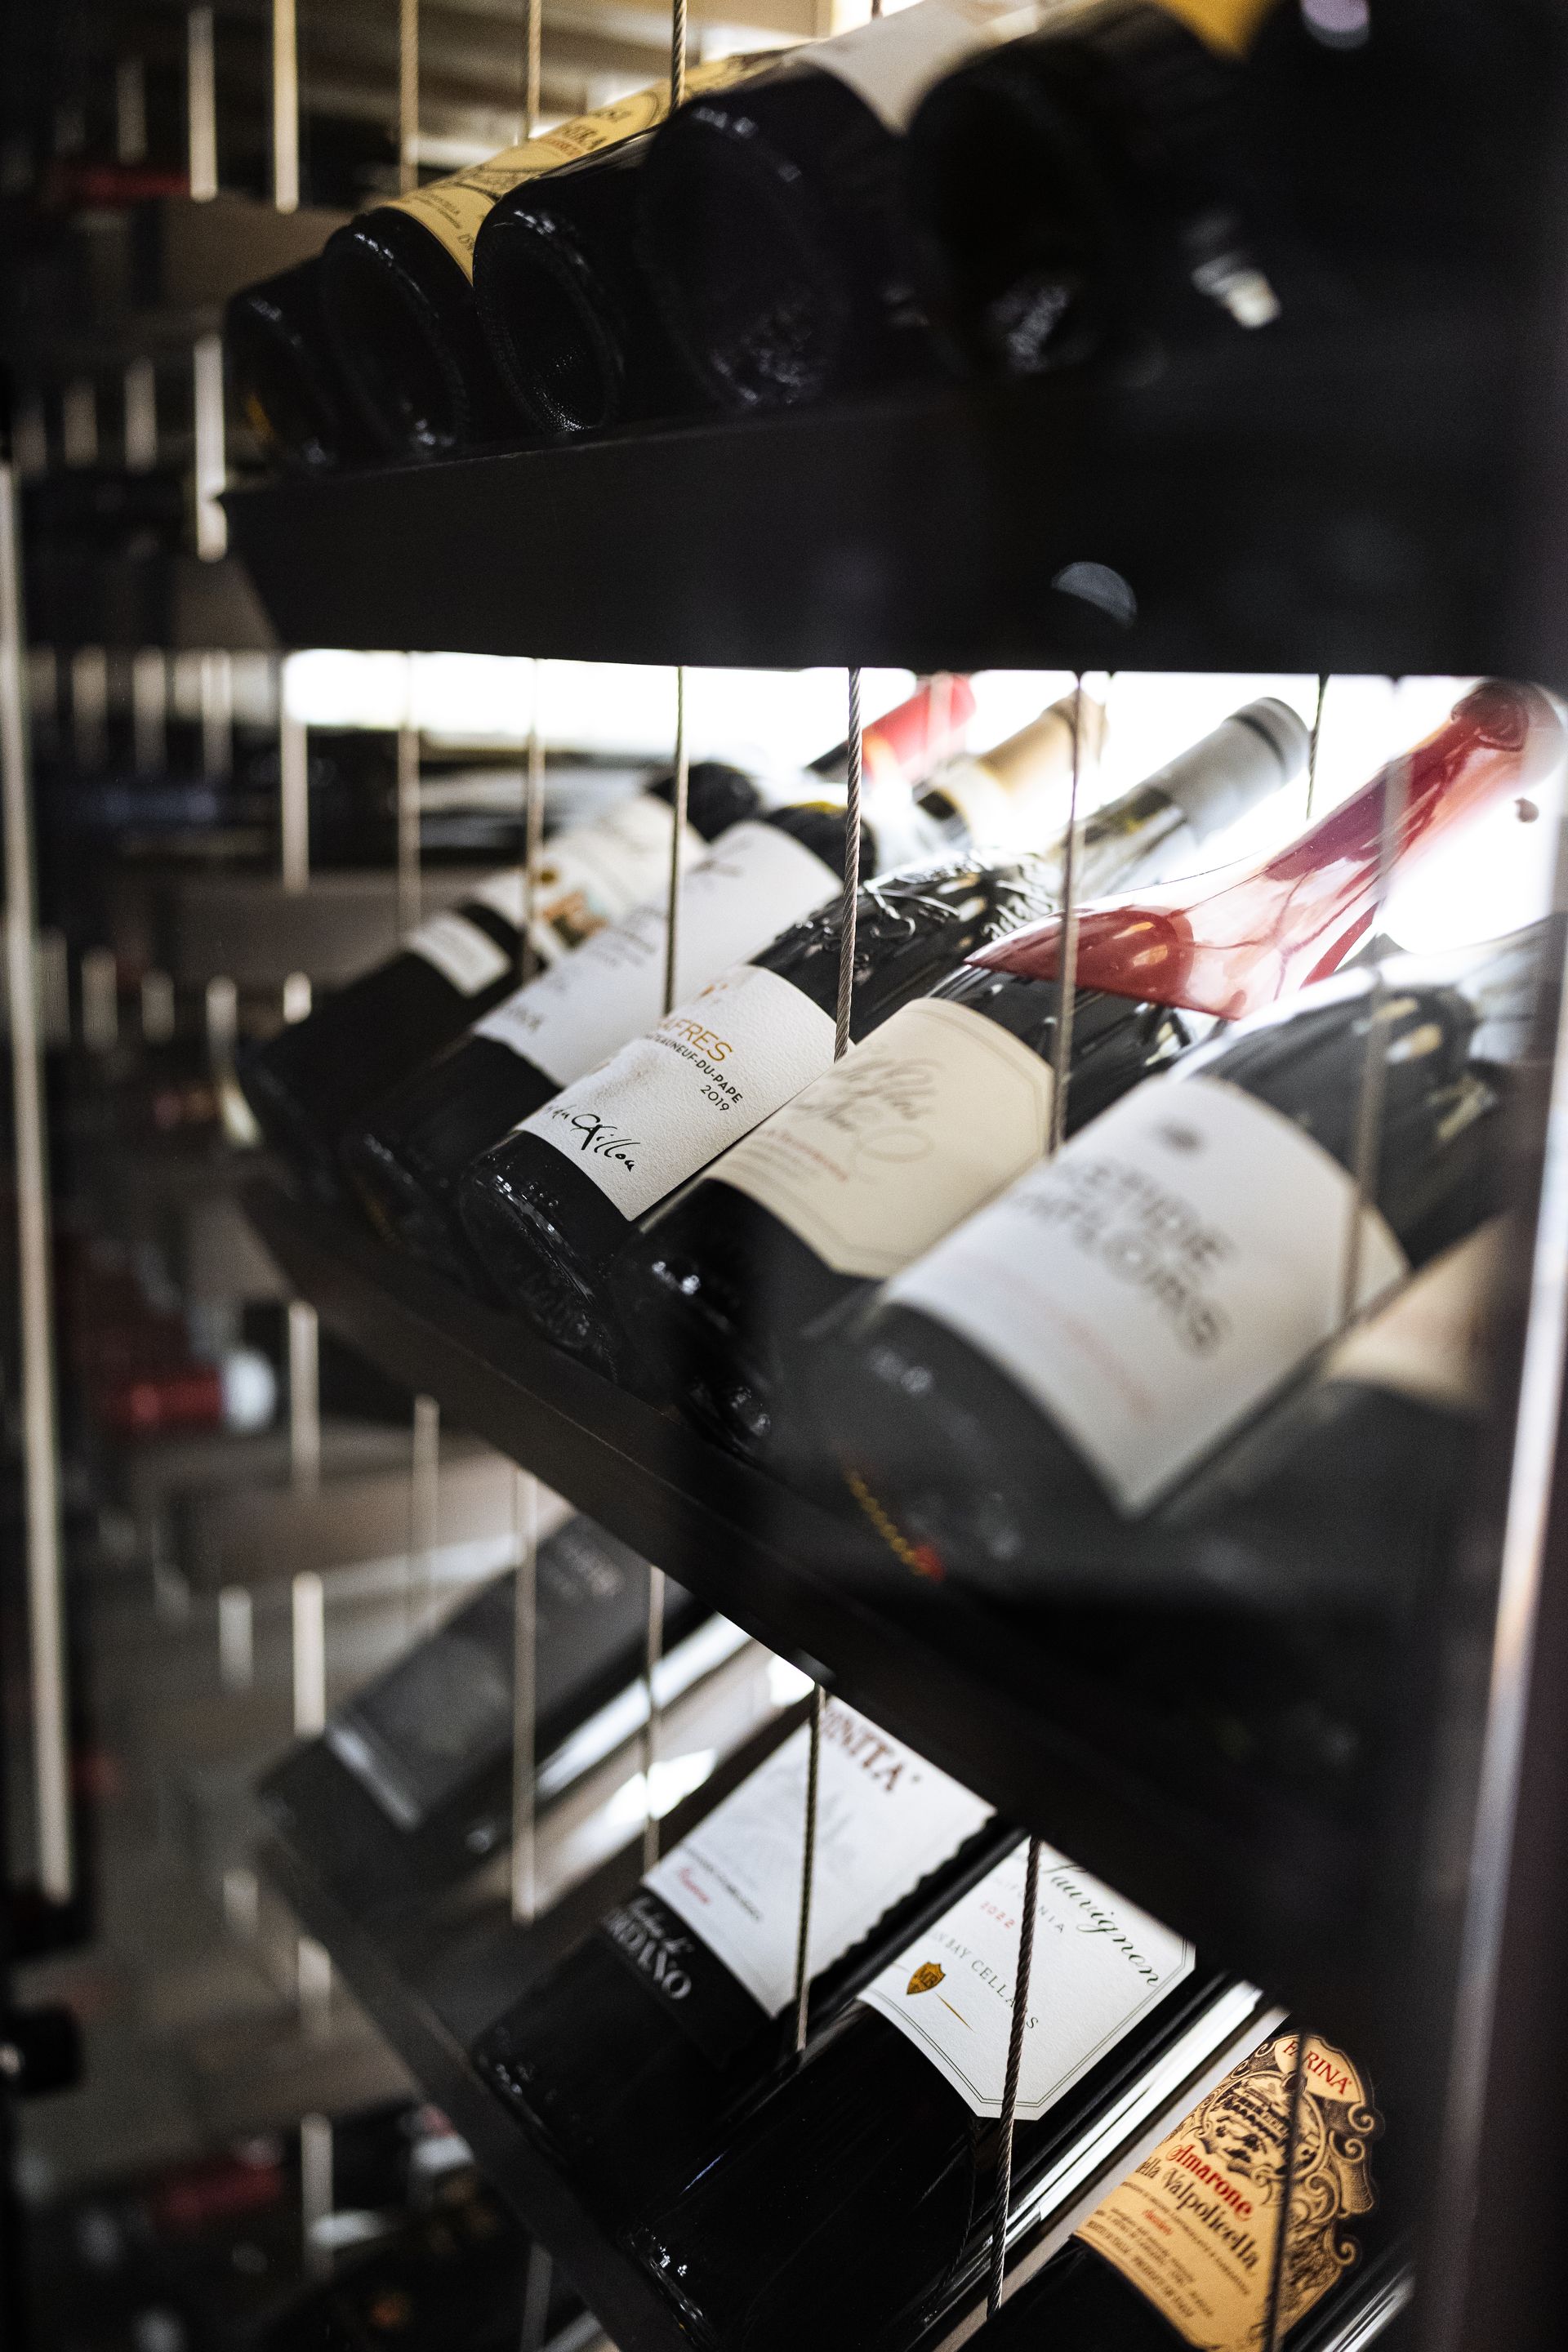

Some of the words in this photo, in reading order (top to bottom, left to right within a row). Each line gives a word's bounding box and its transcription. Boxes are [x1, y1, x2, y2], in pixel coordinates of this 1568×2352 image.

[700, 1084, 731, 1113] 2019
[980, 1901, 1017, 1930] 2022
[970, 1958, 1040, 2030] CELLAS
[1165, 2145, 1254, 2222] Amarone
[1161, 2167, 1262, 2273] Valpolicella
